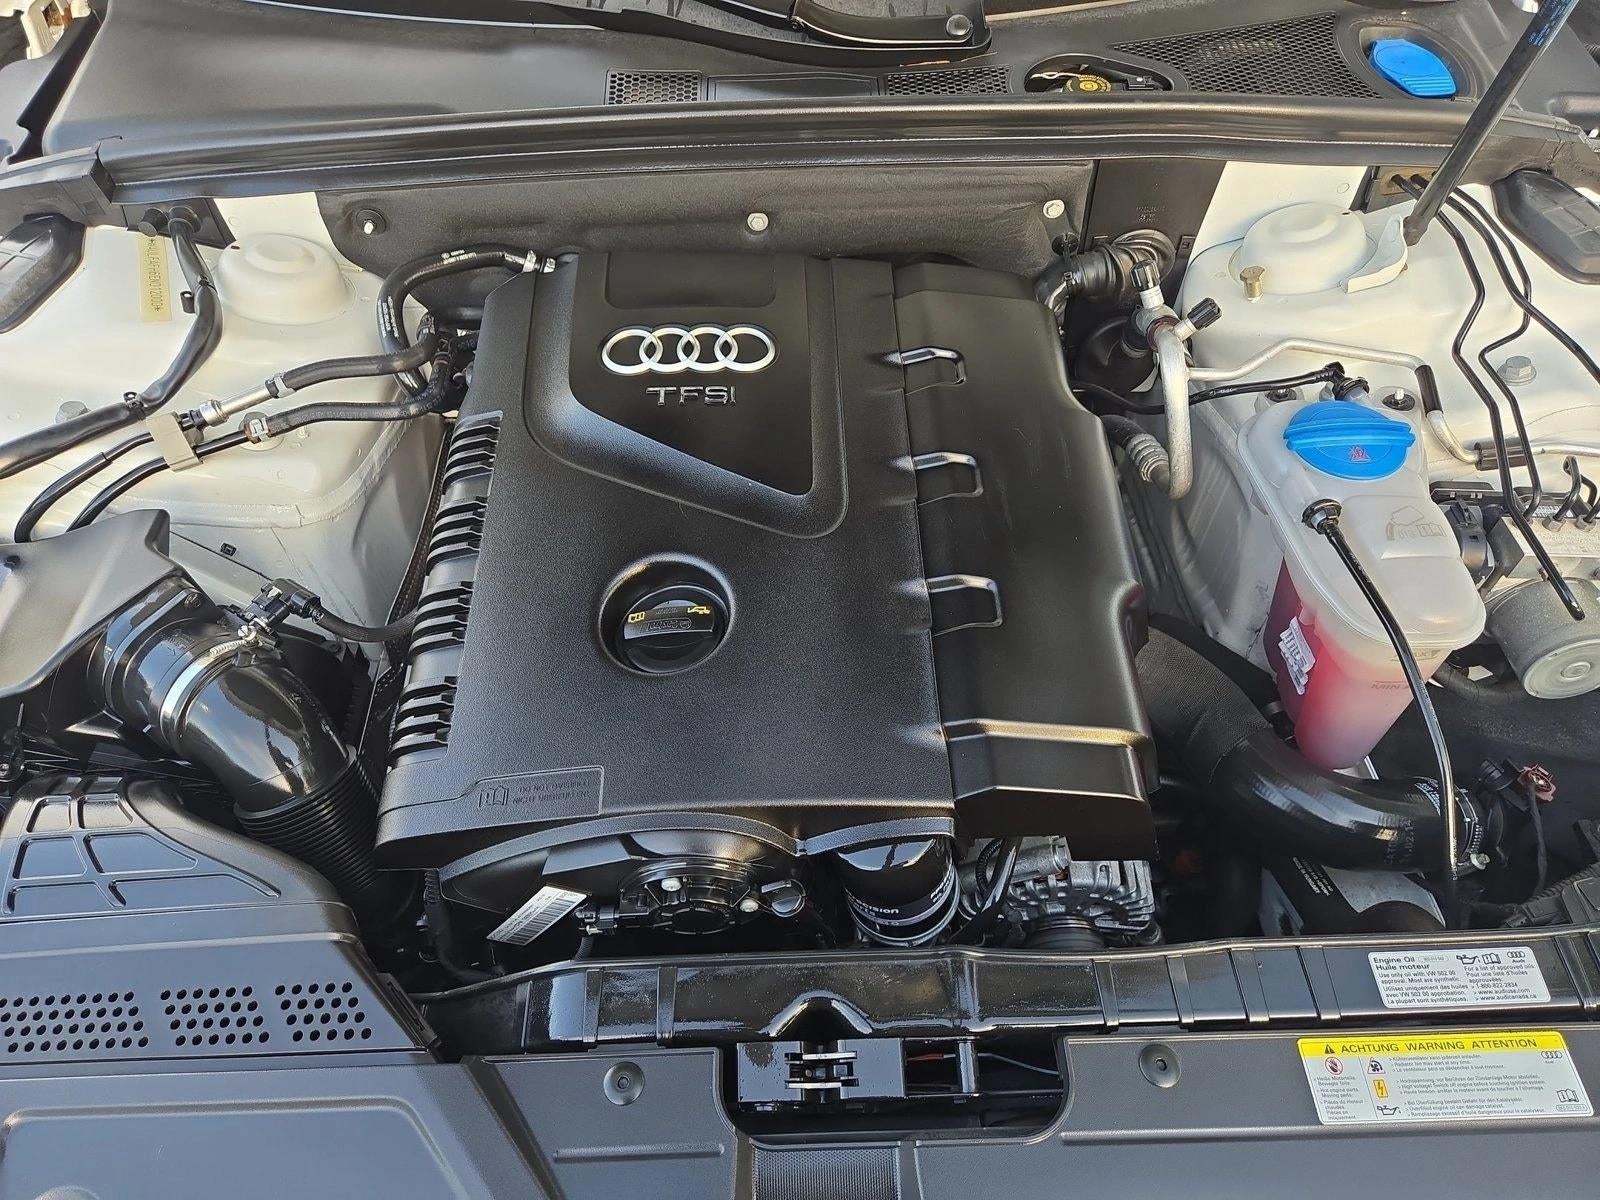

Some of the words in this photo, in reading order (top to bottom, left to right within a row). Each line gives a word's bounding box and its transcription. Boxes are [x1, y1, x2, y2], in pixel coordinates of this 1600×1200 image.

[646, 386, 736, 405] TFSI
[1341, 1043, 1399, 1053] ACHTUNG
[1405, 1041, 1465, 1051] WARNING
[1472, 1038, 1537, 1049] ATTENTION
